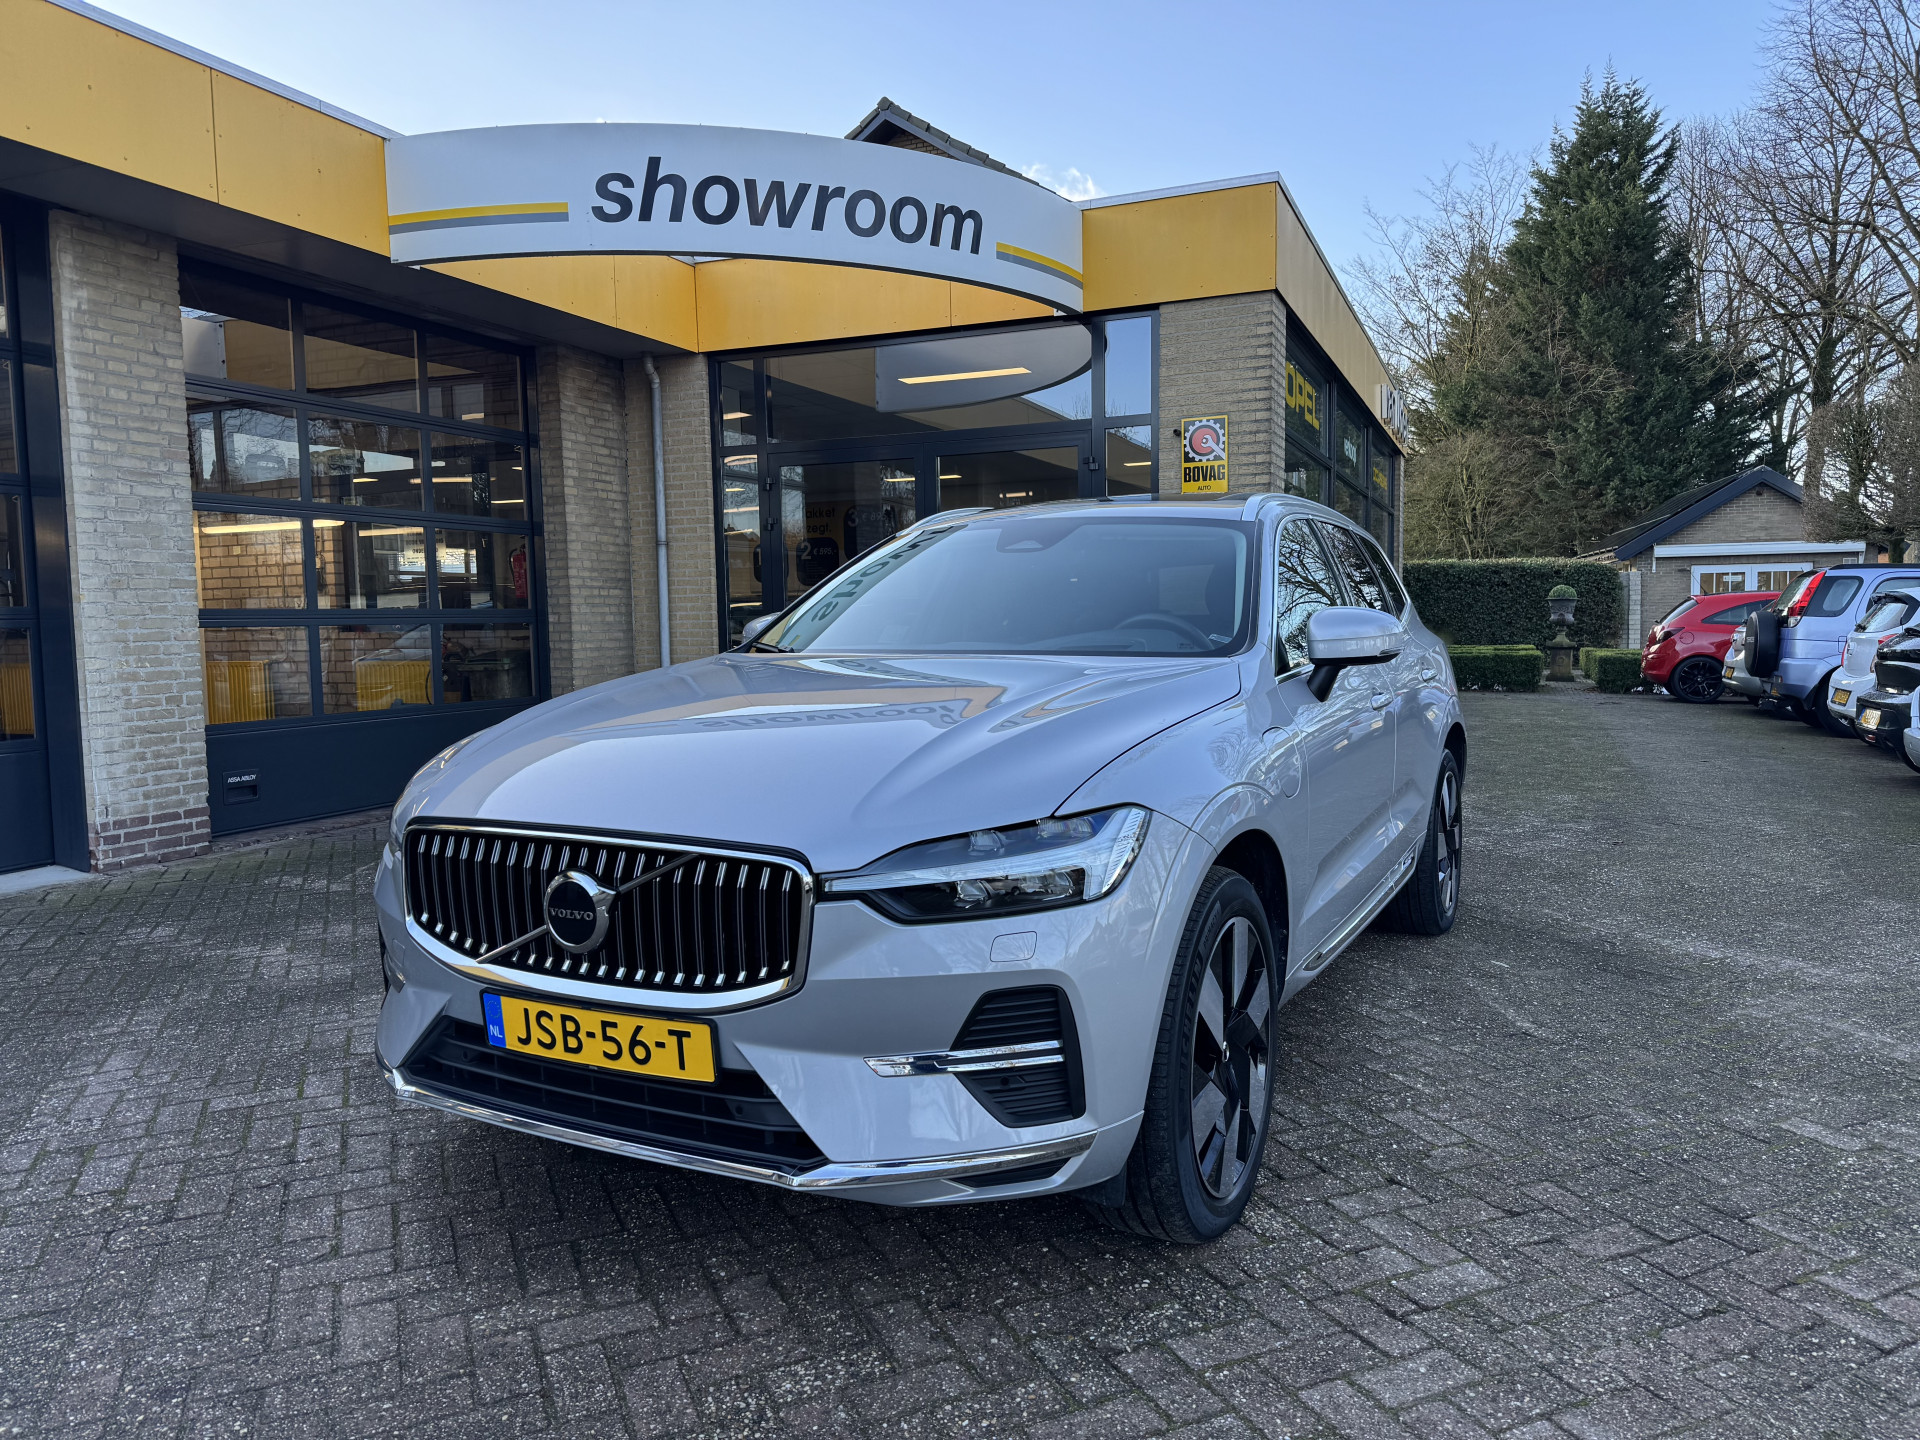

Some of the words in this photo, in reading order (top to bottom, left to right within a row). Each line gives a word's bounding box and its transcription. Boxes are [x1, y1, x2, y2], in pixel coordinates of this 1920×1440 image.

[590, 155, 984, 255] showroom
[1285, 360, 1321, 431] OPEL
[1183, 463, 1226, 484] BOVAG
[800, 541, 812, 560] 2
[549, 907, 594, 921] VOLVO
[489, 1023, 503, 1038] NL
[517, 1007, 692, 1071] JSB-56-T
